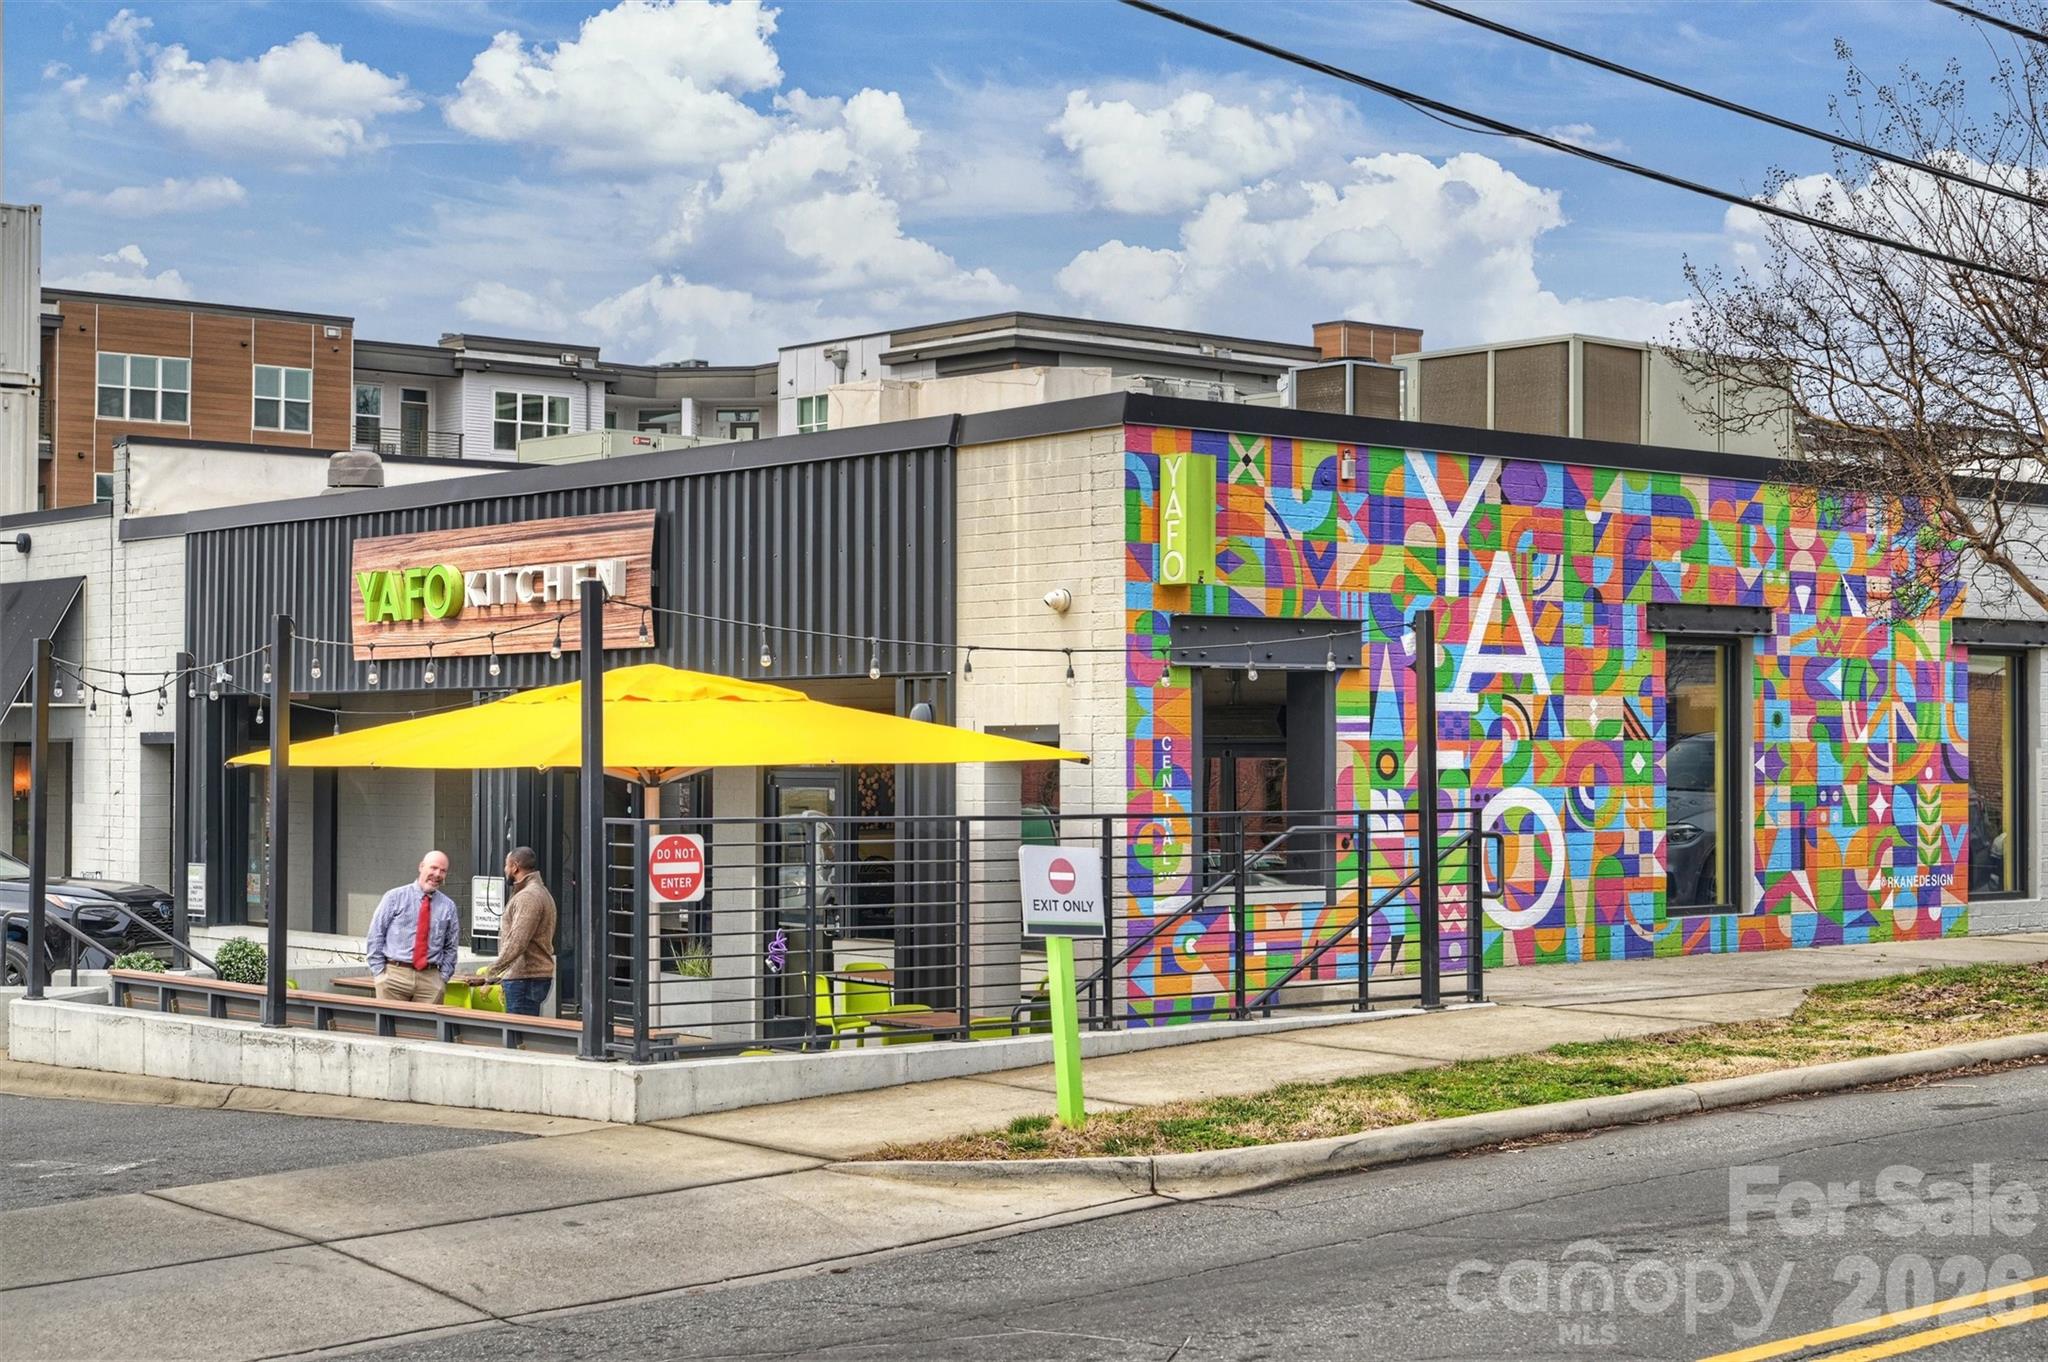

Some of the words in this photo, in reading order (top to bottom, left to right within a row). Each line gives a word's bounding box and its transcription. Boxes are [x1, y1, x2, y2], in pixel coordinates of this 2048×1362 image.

[1163, 456, 1184, 582] YAFO
[355, 564, 464, 623] YAFO
[464, 559, 627, 608] KITCHEN
[656, 849, 671, 860] DO
[674, 848, 695, 859] NOT
[661, 877, 692, 889] ENTER
[1033, 899, 1059, 912] EXIT
[1062, 900, 1095, 913] ONLY
